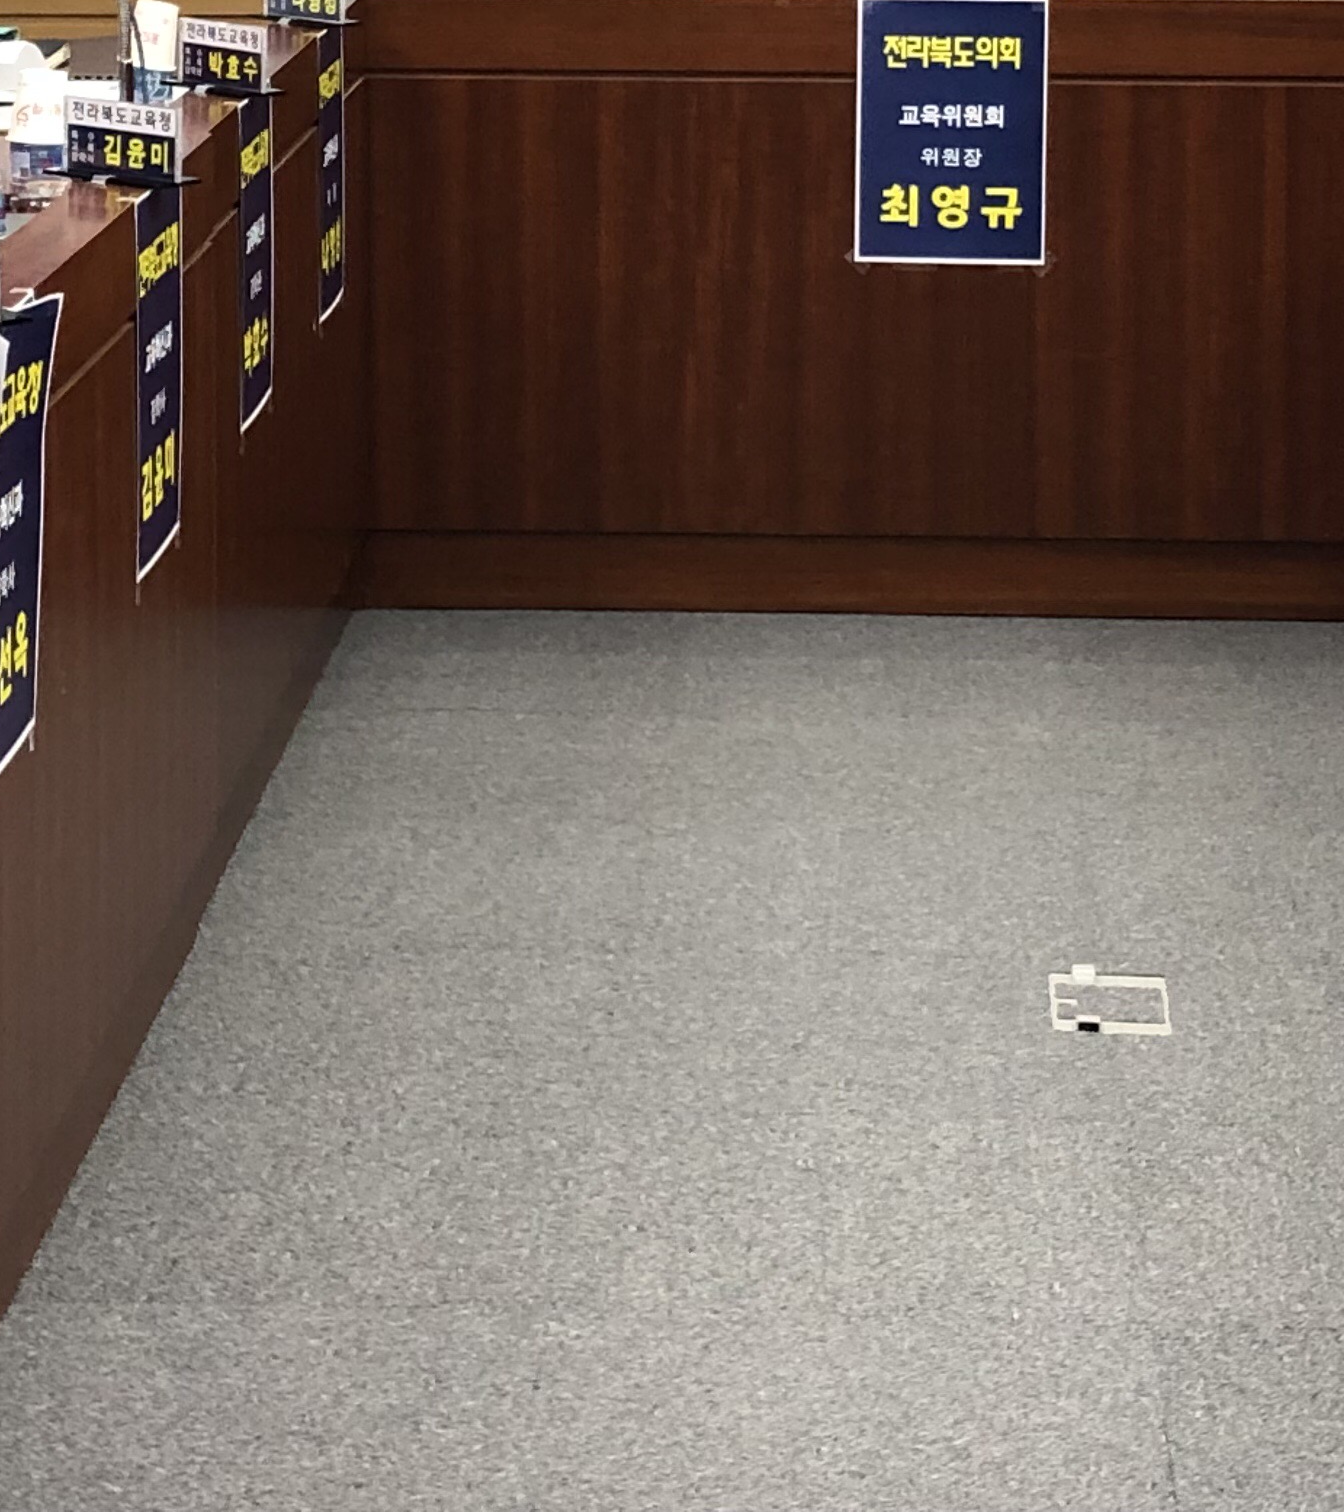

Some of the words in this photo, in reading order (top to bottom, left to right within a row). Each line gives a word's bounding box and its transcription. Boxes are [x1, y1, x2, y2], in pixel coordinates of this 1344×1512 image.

[208, 51, 258, 83] 박효수
[883, 35, 1022, 69] 전라북도의회
[72, 101, 172, 132] 전라북도교육청
[898, 104, 1005, 129] 교육위원회
[103, 134, 169, 174] 김윤미
[920, 147, 983, 168] 위원장
[879, 184, 1023, 229] 최영규
